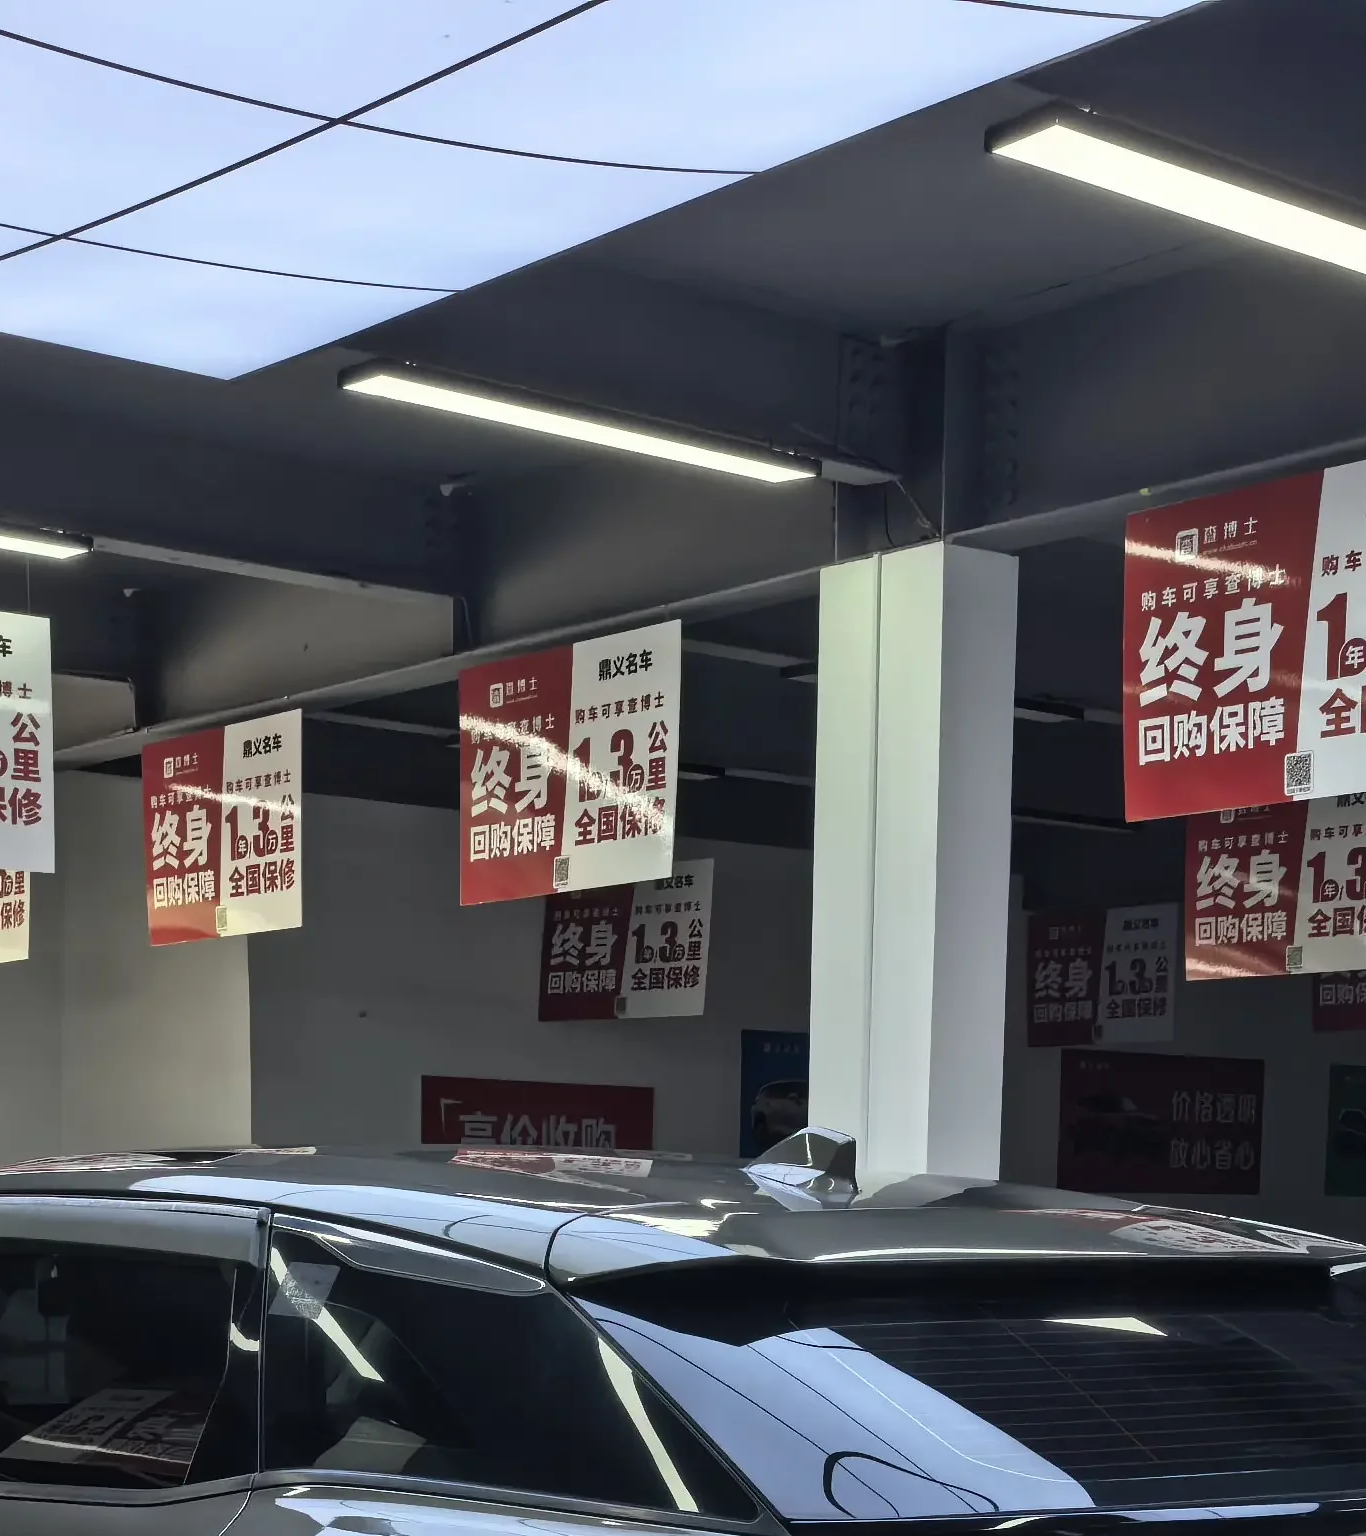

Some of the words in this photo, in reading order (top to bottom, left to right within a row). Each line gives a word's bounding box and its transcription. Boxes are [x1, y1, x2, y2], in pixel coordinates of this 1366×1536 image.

[598, 649, 653, 681] 鼎义名车
[1140, 598, 1284, 707] 终身
[574, 691, 665, 725] 购车可享查博士
[243, 733, 282, 759] 鼎义名车
[1139, 696, 1285, 765] 回购保障
[226, 769, 291, 794] 购车可享查博士
[471, 746, 553, 818] 终身
[151, 804, 212, 871] 终身
[470, 813, 555, 862] 回购保障
[1198, 831, 1288, 852] 购车可享查博士
[153, 869, 215, 909] 回购保障
[228, 858, 295, 898] 全国保修
[1196, 849, 1287, 910] 终身
[550, 920, 618, 967] 终身
[1195, 911, 1287, 946] 回购保障
[548, 969, 616, 994] 回购保障
[631, 965, 700, 991] 全国保修
[1034, 957, 1093, 999] 终身
